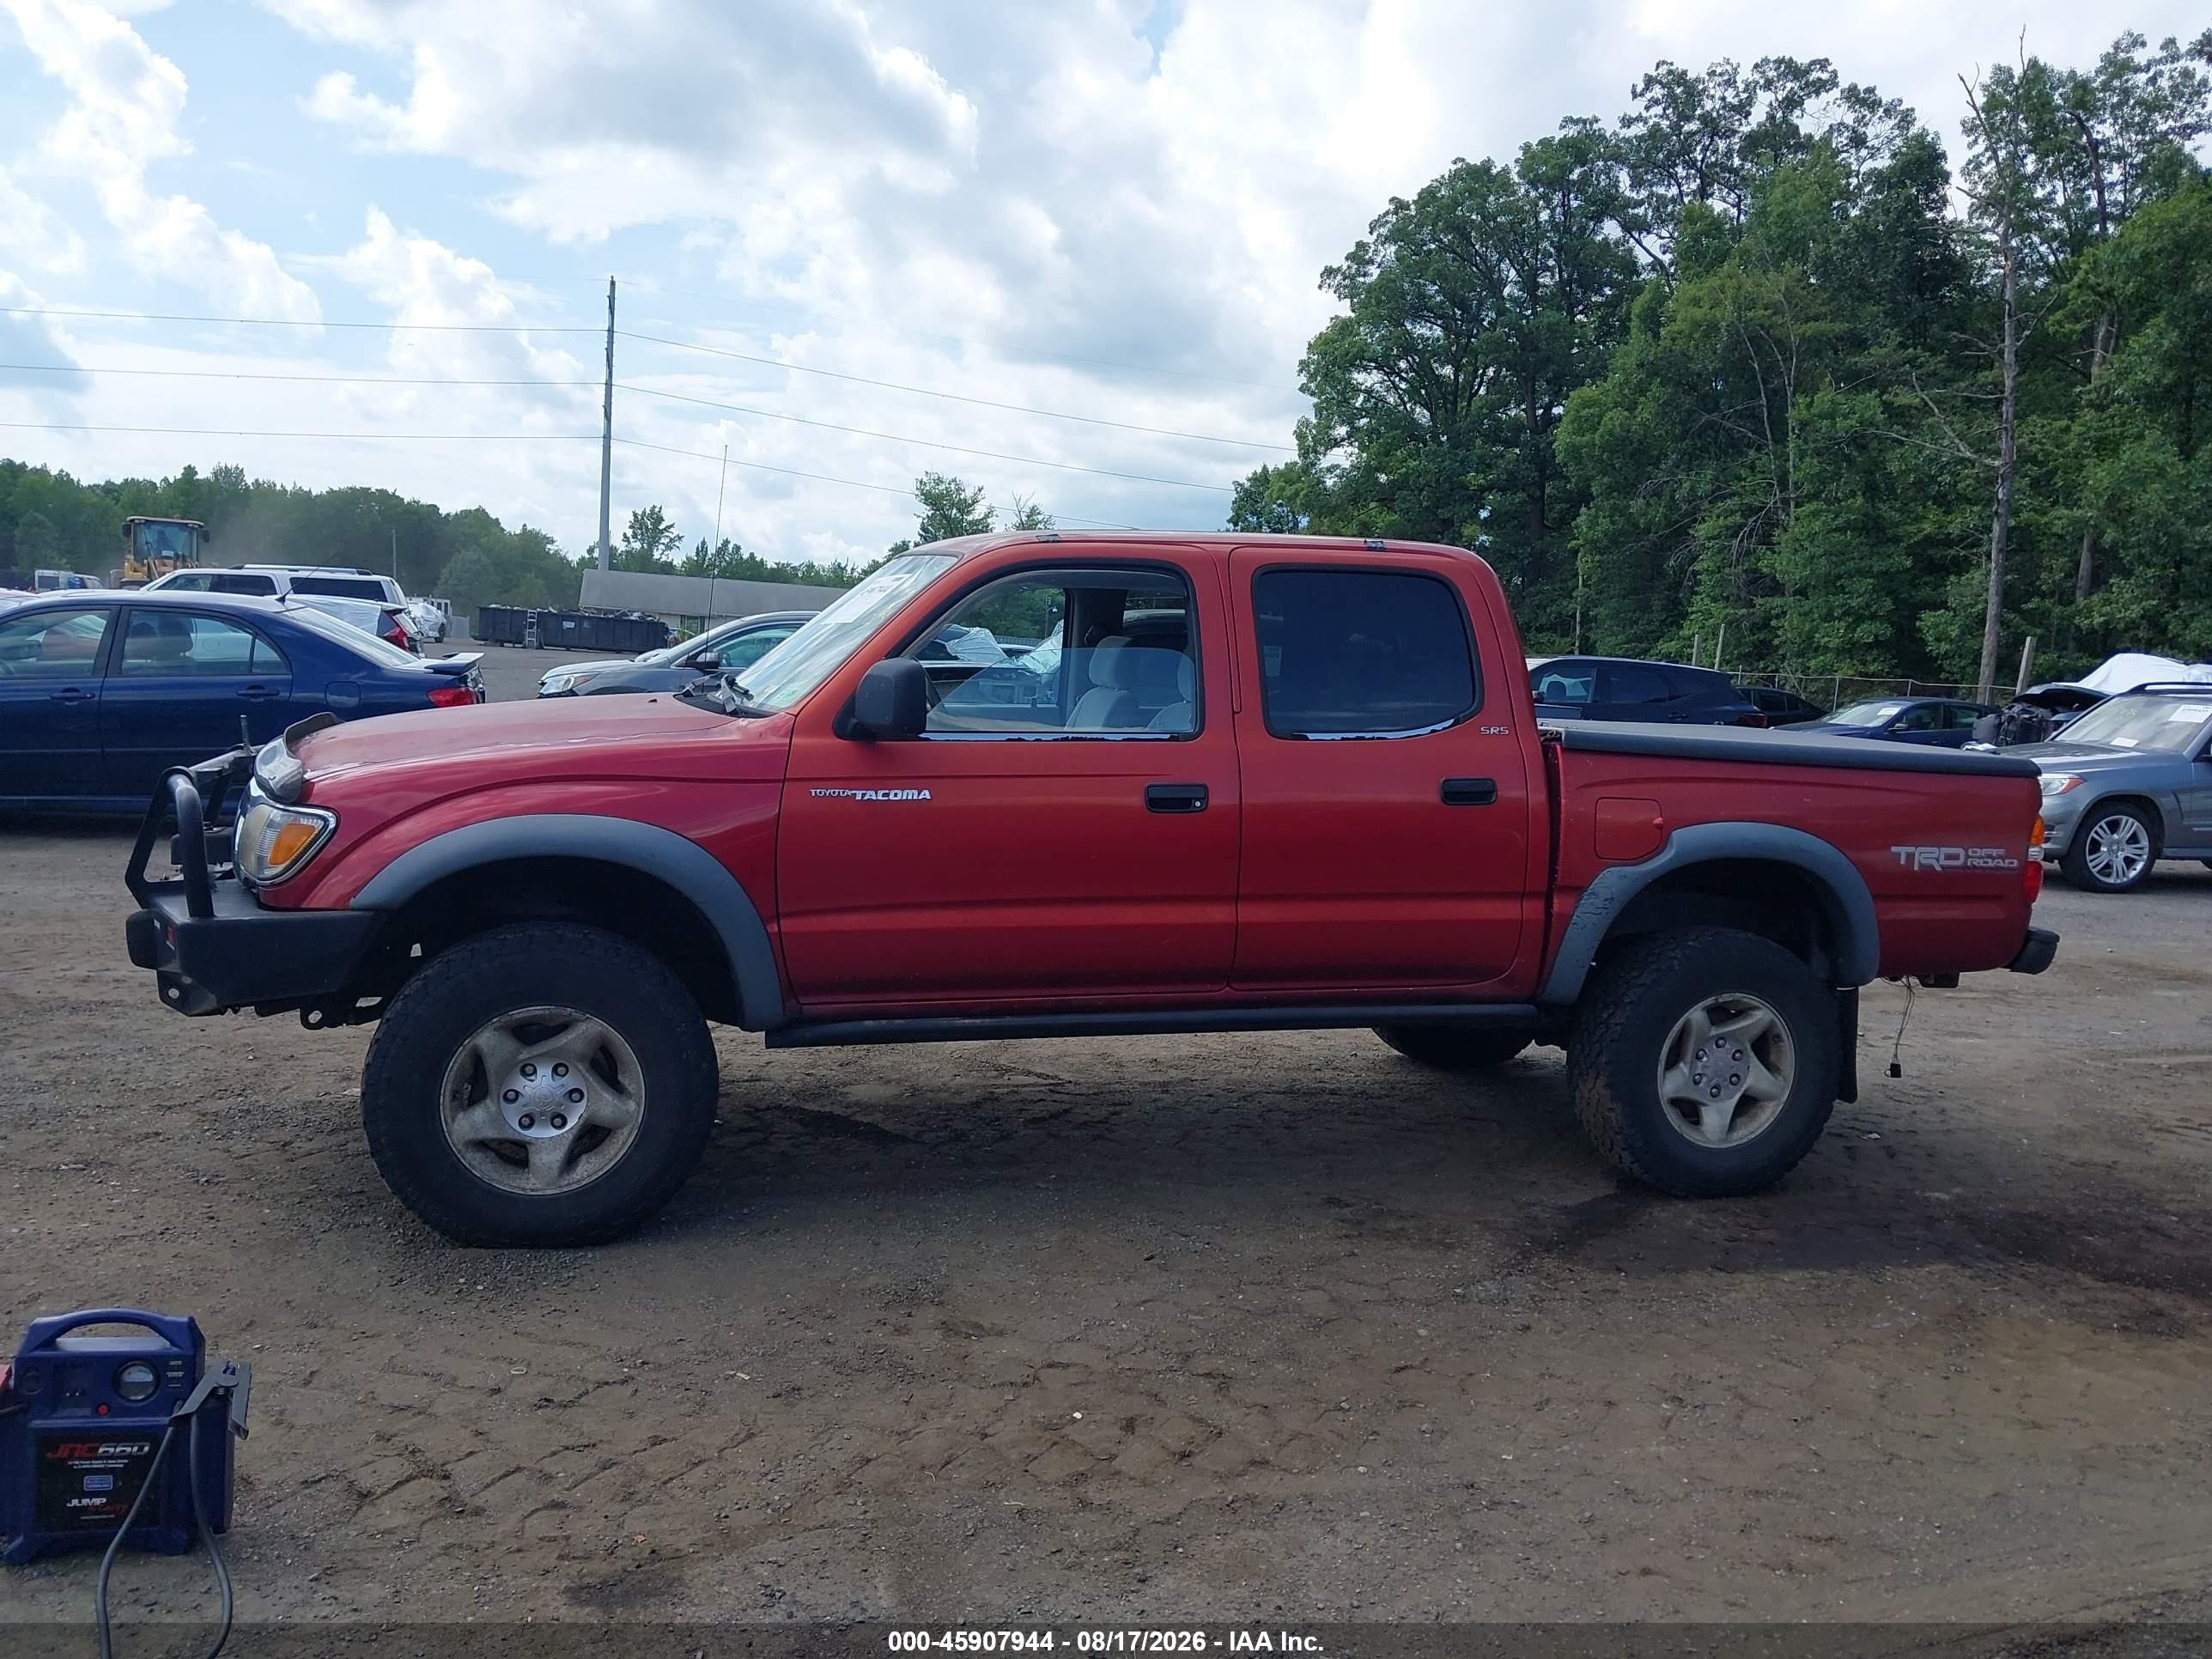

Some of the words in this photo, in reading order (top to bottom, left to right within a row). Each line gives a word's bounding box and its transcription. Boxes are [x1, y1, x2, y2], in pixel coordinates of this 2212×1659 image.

[810, 788, 852, 797] TOYOTA
[853, 789, 932, 800] TACOMA
[1967, 848, 2006, 857] OFF
[1891, 846, 1966, 872] TRD
[1966, 858, 2019, 867] ROAD
[66, 1498, 107, 1507] JUMP
